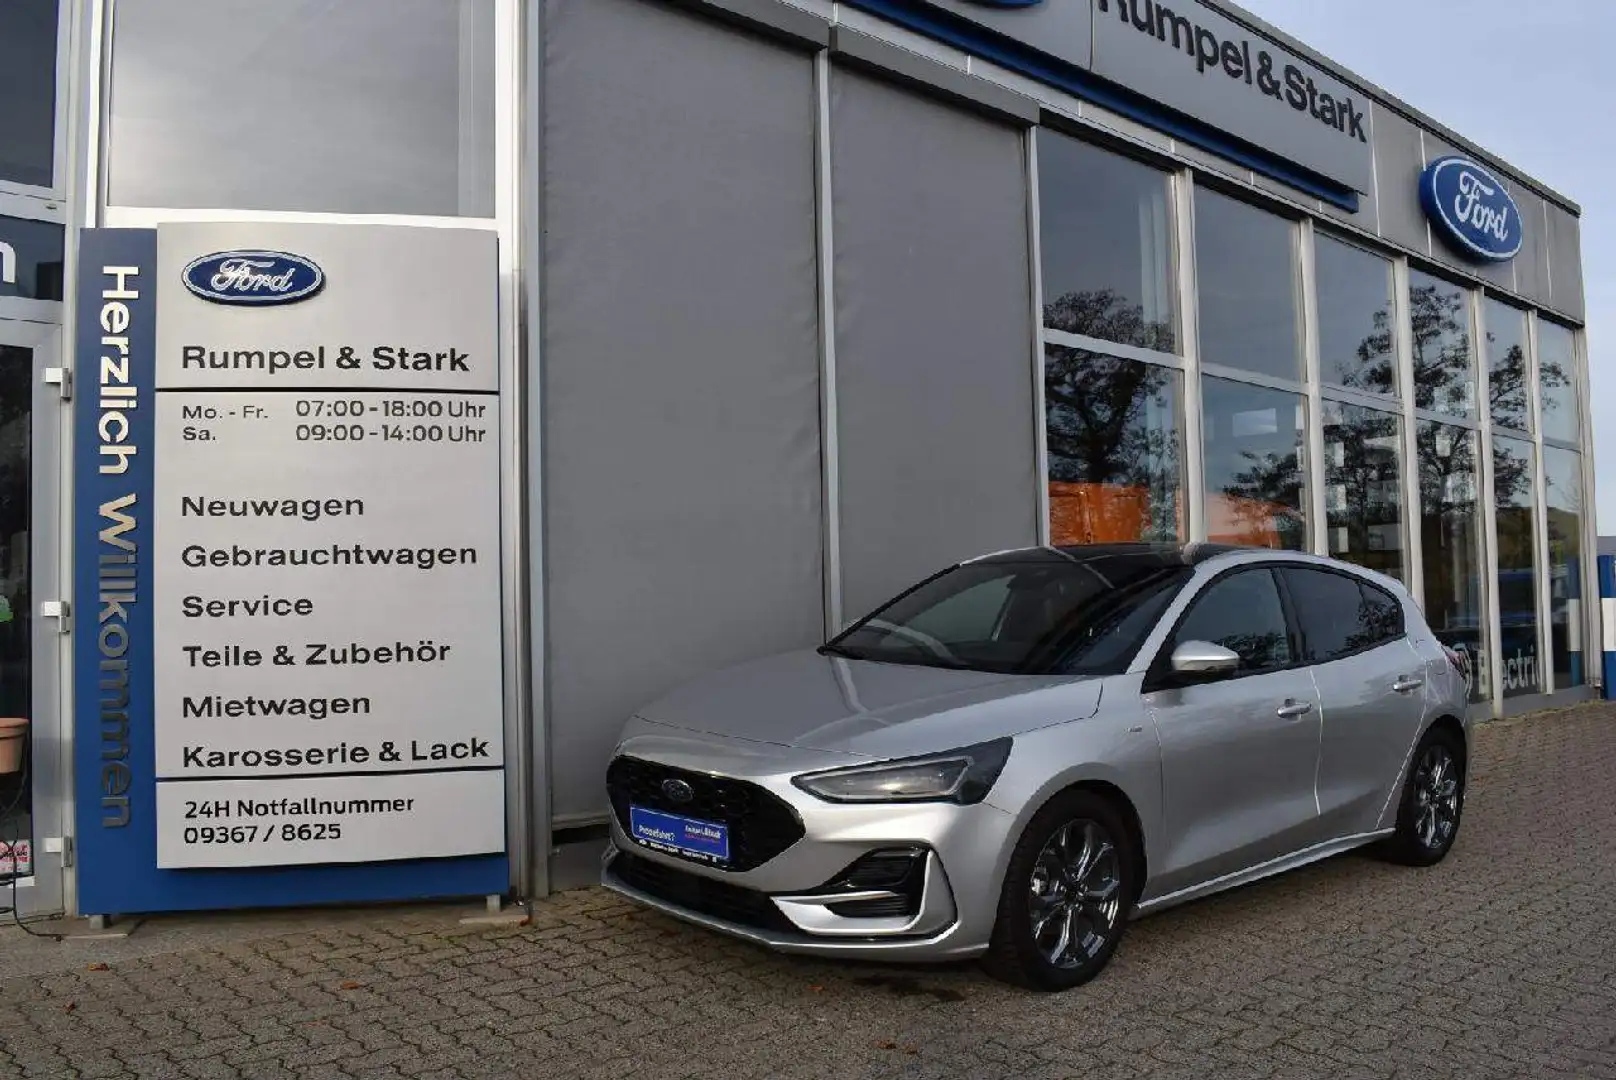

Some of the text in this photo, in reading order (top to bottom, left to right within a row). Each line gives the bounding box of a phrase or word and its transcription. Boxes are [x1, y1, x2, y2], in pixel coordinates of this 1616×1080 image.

[1455, 171, 1508, 242] Ford
[211, 258, 296, 292] Ford
[182, 346, 470, 375] Rumpel & Stark
[182, 405, 223, 419] Mo.
[243, 404, 268, 419] Fr.
[295, 400, 365, 417] 07:00
[382, 401, 443, 417] 18:00
[448, 400, 486, 418] Uhr
[183, 426, 216, 441] Sa.
[295, 425, 365, 441] 09:00
[382, 425, 443, 442] 14:00
[448, 424, 486, 443] Uhr
[182, 496, 364, 522] Neuwagen
[98, 266, 139, 829] Herzlich Willkommen
[182, 544, 477, 570] Gebrauchtwagen
[182, 594, 313, 618] Service
[183, 640, 451, 668] Teile & Zubehör
[182, 694, 371, 720] Mietwagen
[183, 737, 490, 768] Karosserie & Lack
[184, 796, 415, 819] 24H Notfallnummer
[183, 825, 258, 844] 09367
[281, 823, 341, 842] 8625
